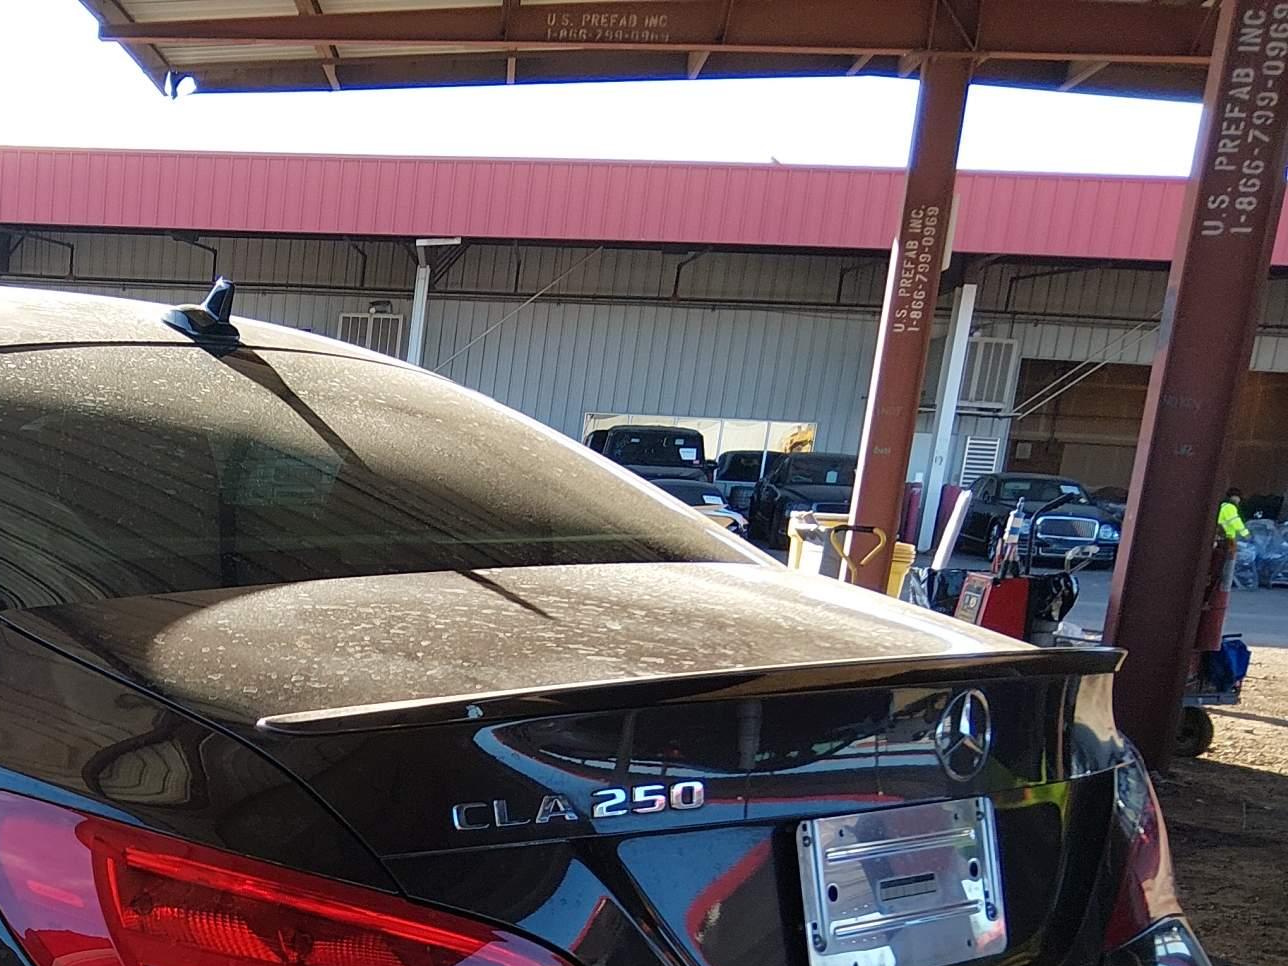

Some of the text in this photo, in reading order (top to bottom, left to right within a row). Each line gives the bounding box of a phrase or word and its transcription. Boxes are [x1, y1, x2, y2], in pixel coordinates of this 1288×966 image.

[582, 13, 637, 27] PREFAB
[1214, 67, 1255, 170] PREFAB
[1201, 187, 1232, 235] U.S.
[893, 204, 926, 332] U.S. PREFAB INC.
[907, 206, 940, 332] 1-866-799-0969
[452, 780, 705, 831] CLA 250
